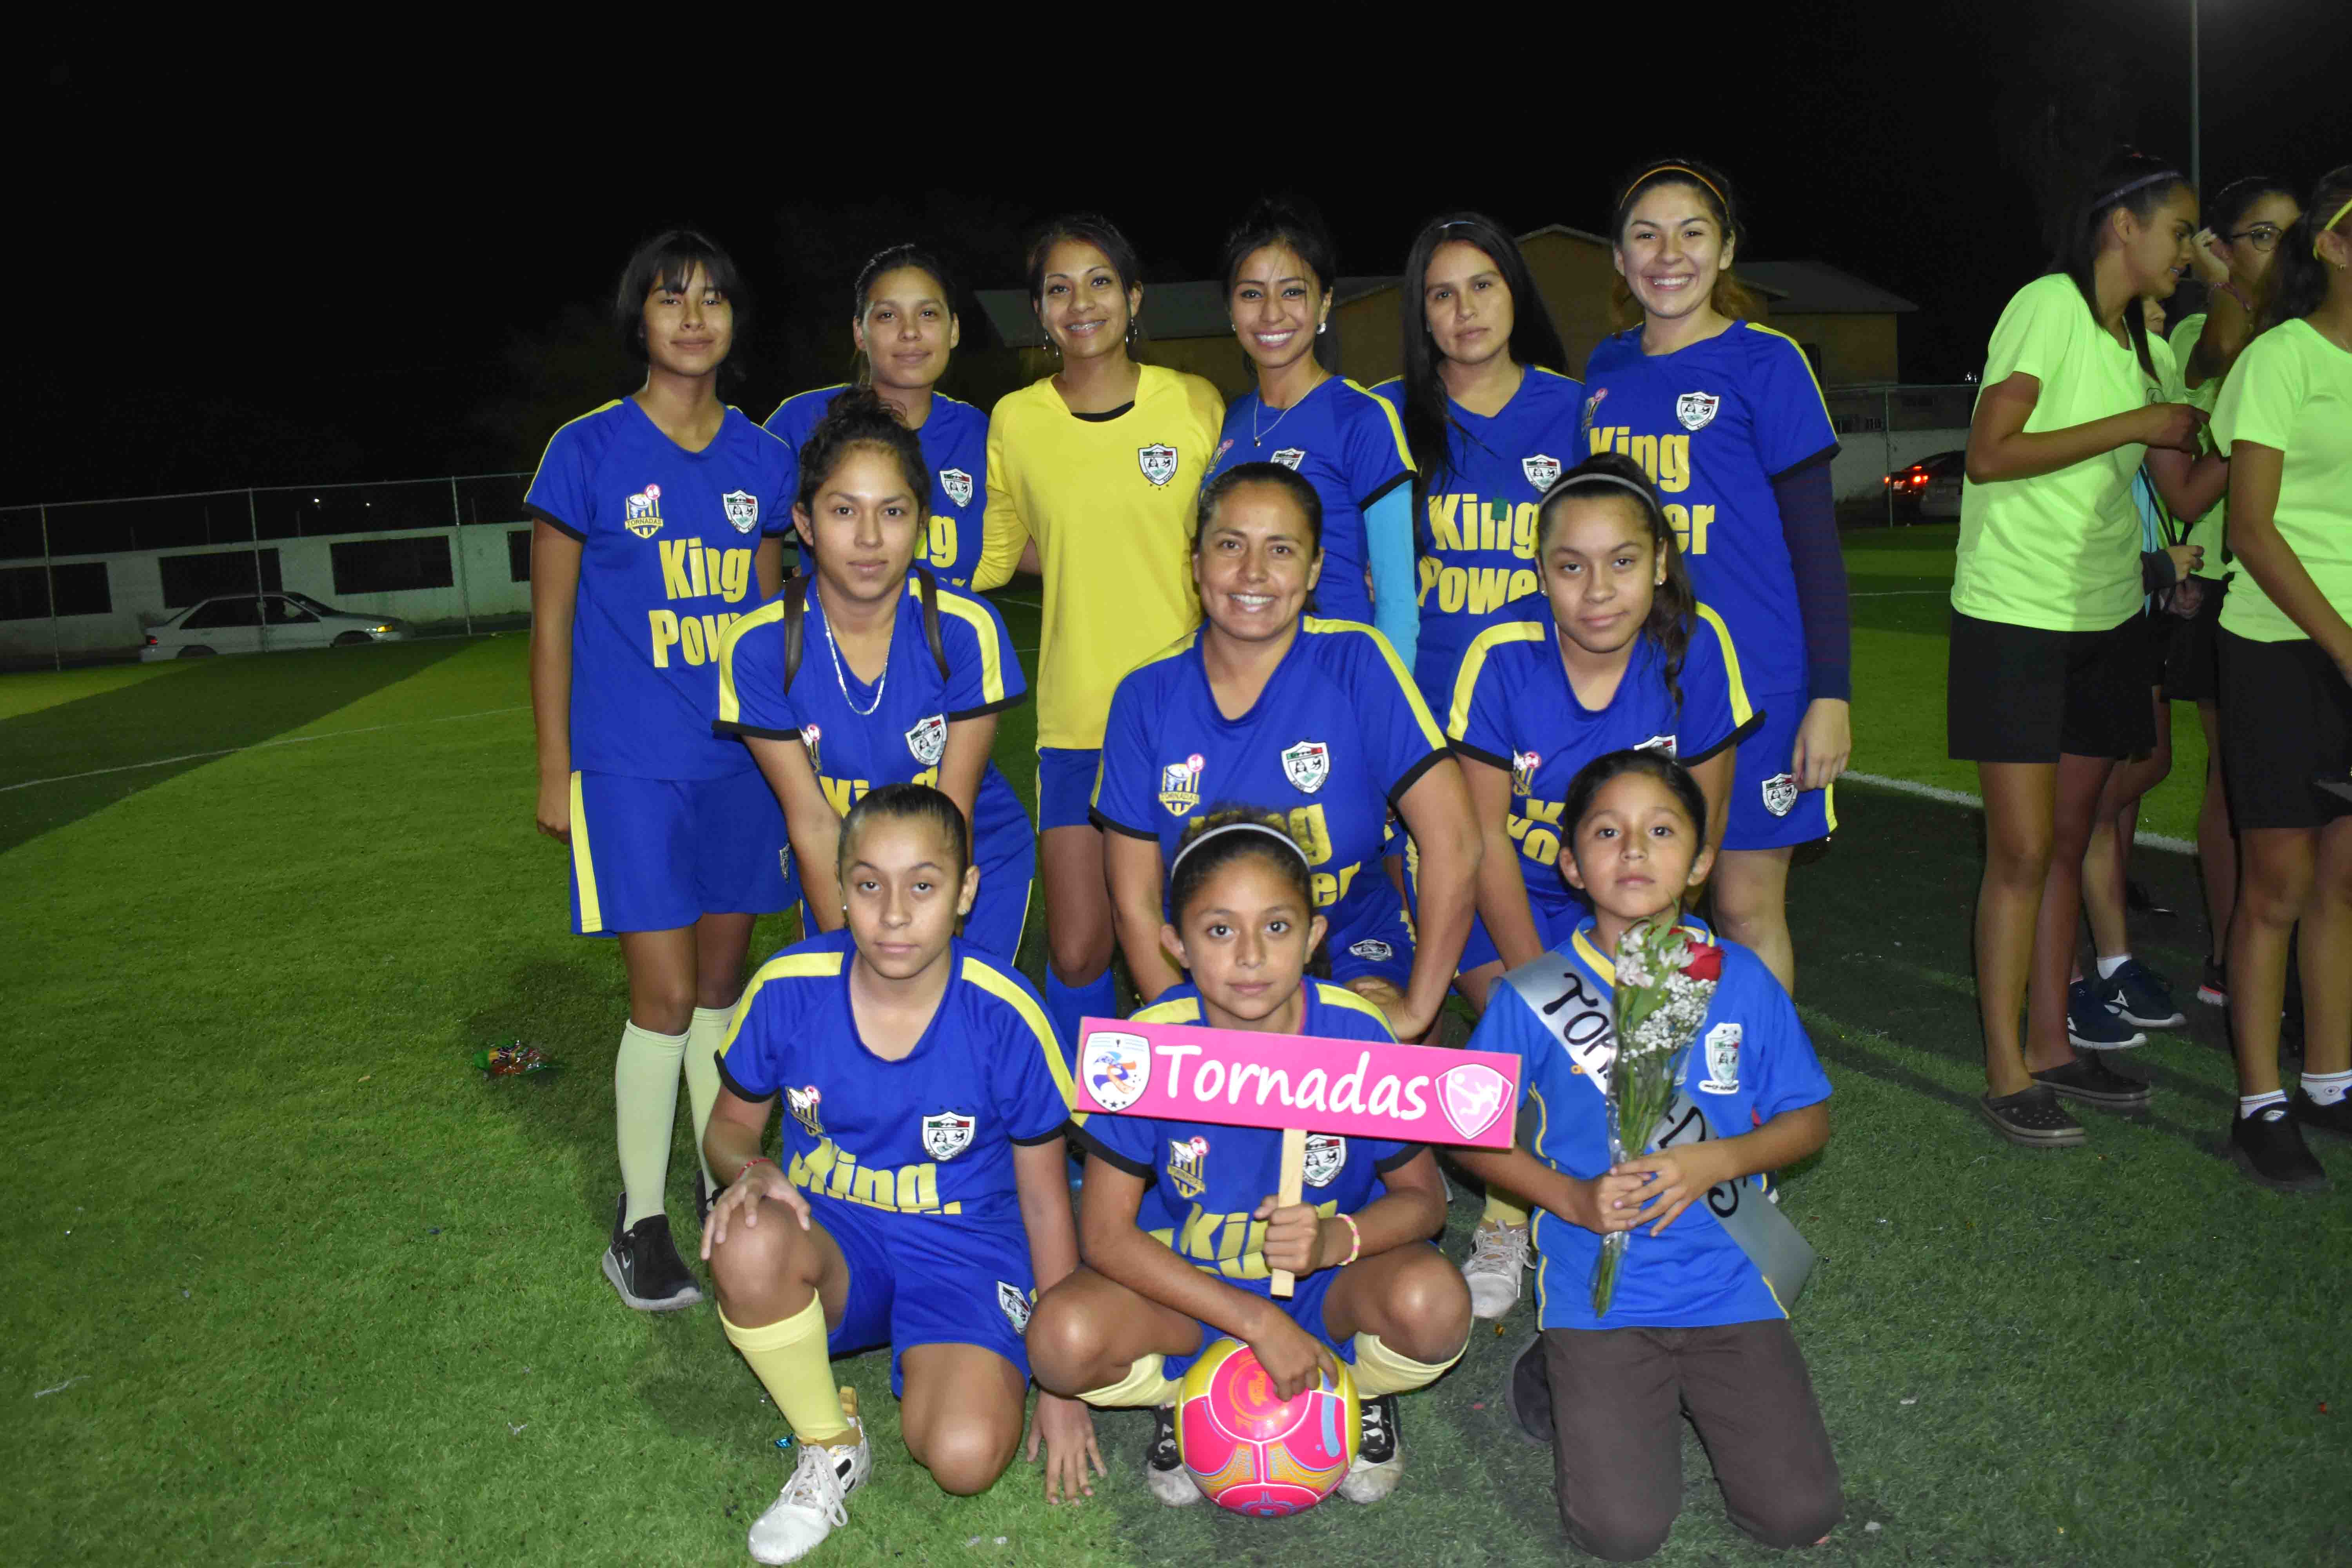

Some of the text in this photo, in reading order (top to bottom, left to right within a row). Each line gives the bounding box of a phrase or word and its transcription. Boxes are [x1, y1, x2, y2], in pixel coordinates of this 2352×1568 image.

[1428, 494, 1541, 559] King
[659, 537, 751, 603] King
[1417, 556, 1538, 615] Powe
[649, 610, 741, 668] Pow
[1155, 1045, 1429, 1120] Tornadas
